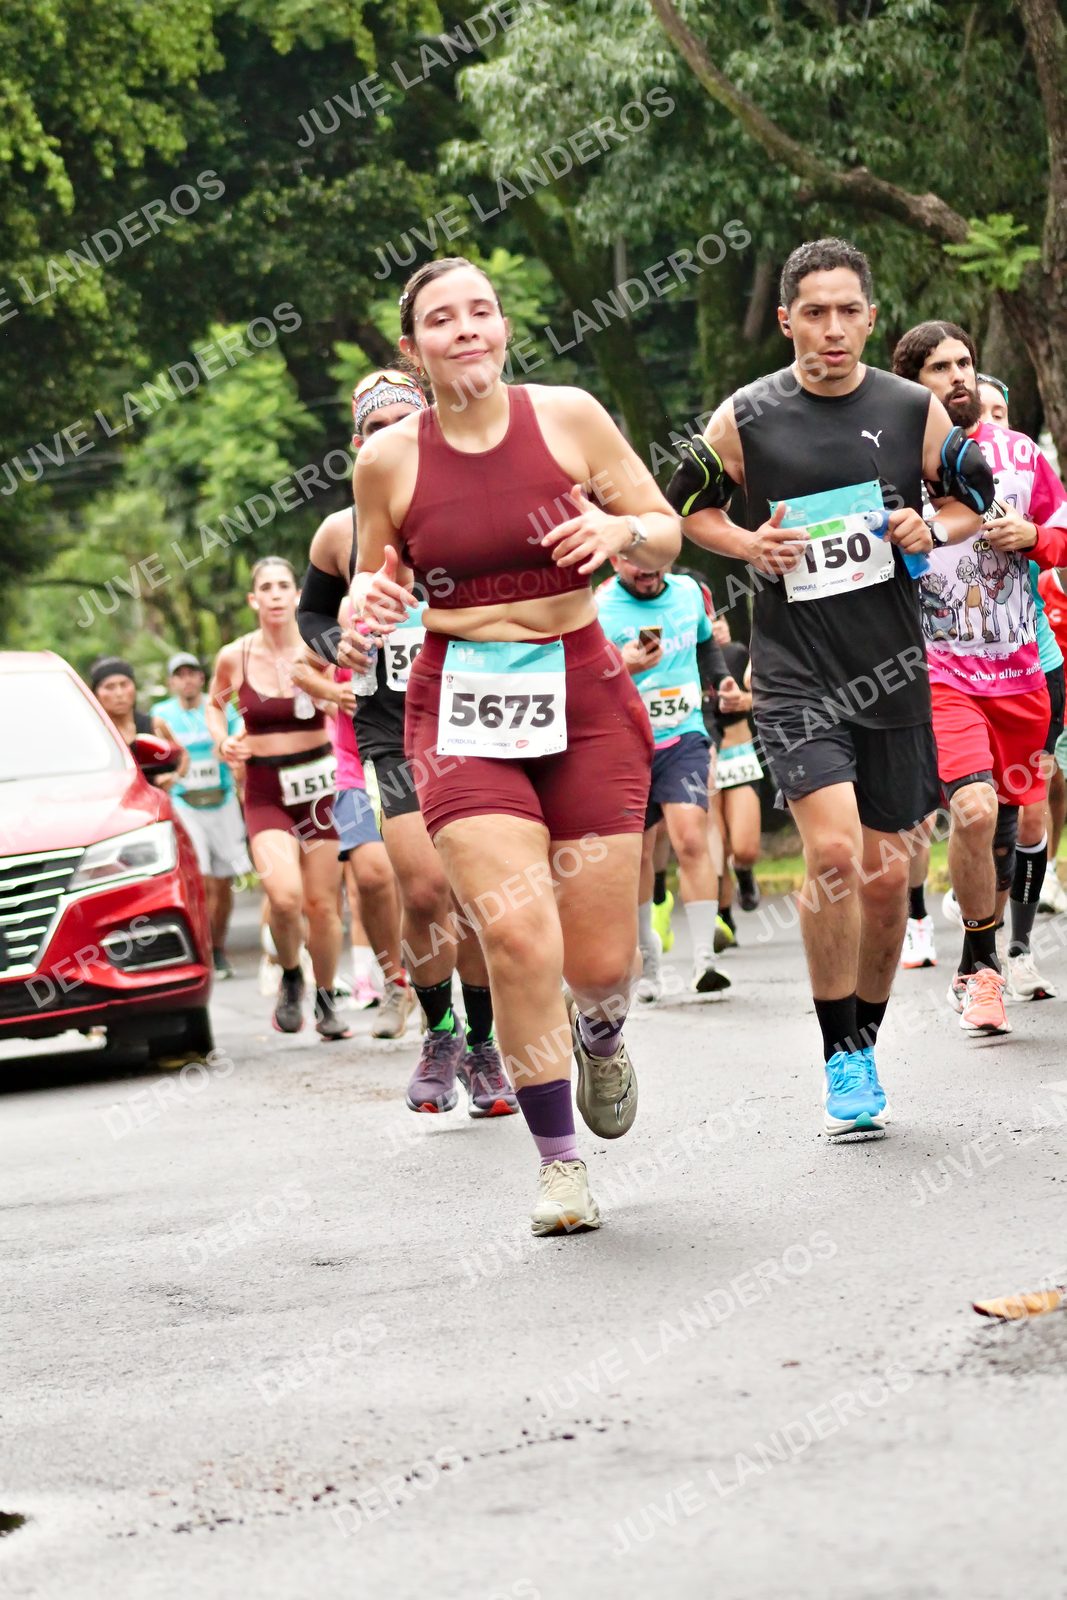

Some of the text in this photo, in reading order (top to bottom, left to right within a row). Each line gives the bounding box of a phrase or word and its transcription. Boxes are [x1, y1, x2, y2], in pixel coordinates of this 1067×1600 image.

[804, 532, 871, 574] 150
[444, 566, 575, 606] AUCONY
[448, 692, 555, 729] 5673
[650, 697, 689, 717] 534
